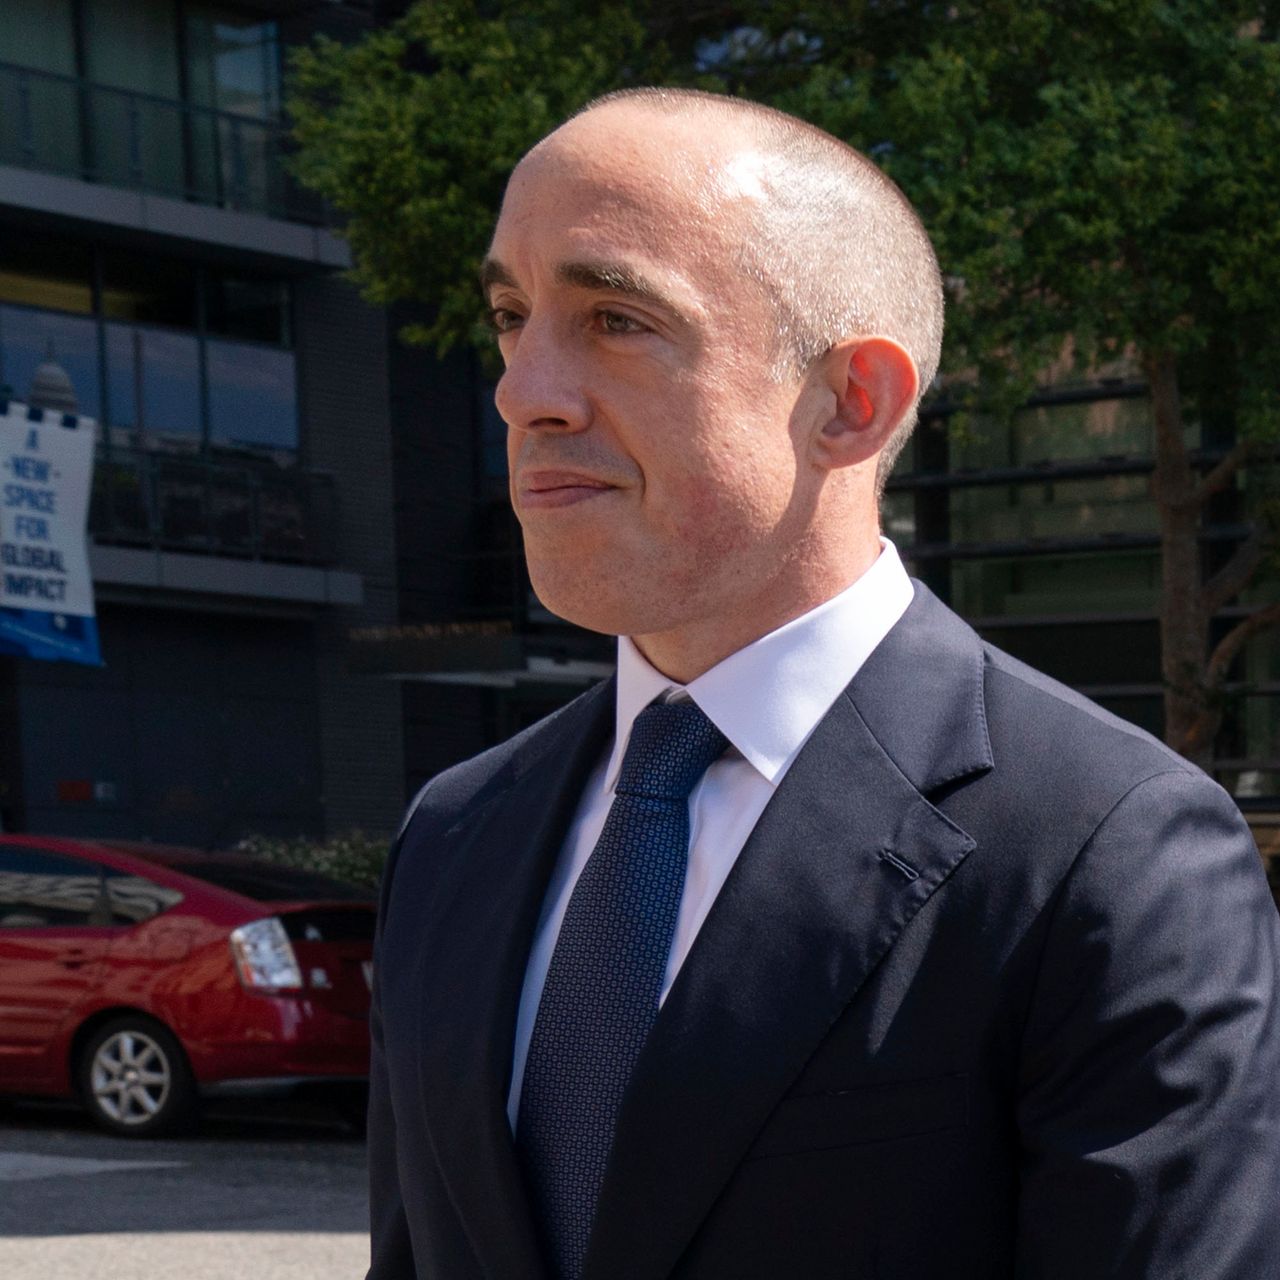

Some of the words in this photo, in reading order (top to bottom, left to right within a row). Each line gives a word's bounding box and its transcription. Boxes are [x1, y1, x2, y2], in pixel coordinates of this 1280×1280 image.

[11, 456, 51, 483] NEW
[4, 483, 55, 515] SPACE
[15, 514, 50, 541] FOR
[1, 542, 66, 574] GLOBAL
[3, 572, 67, 601] IMPACT
